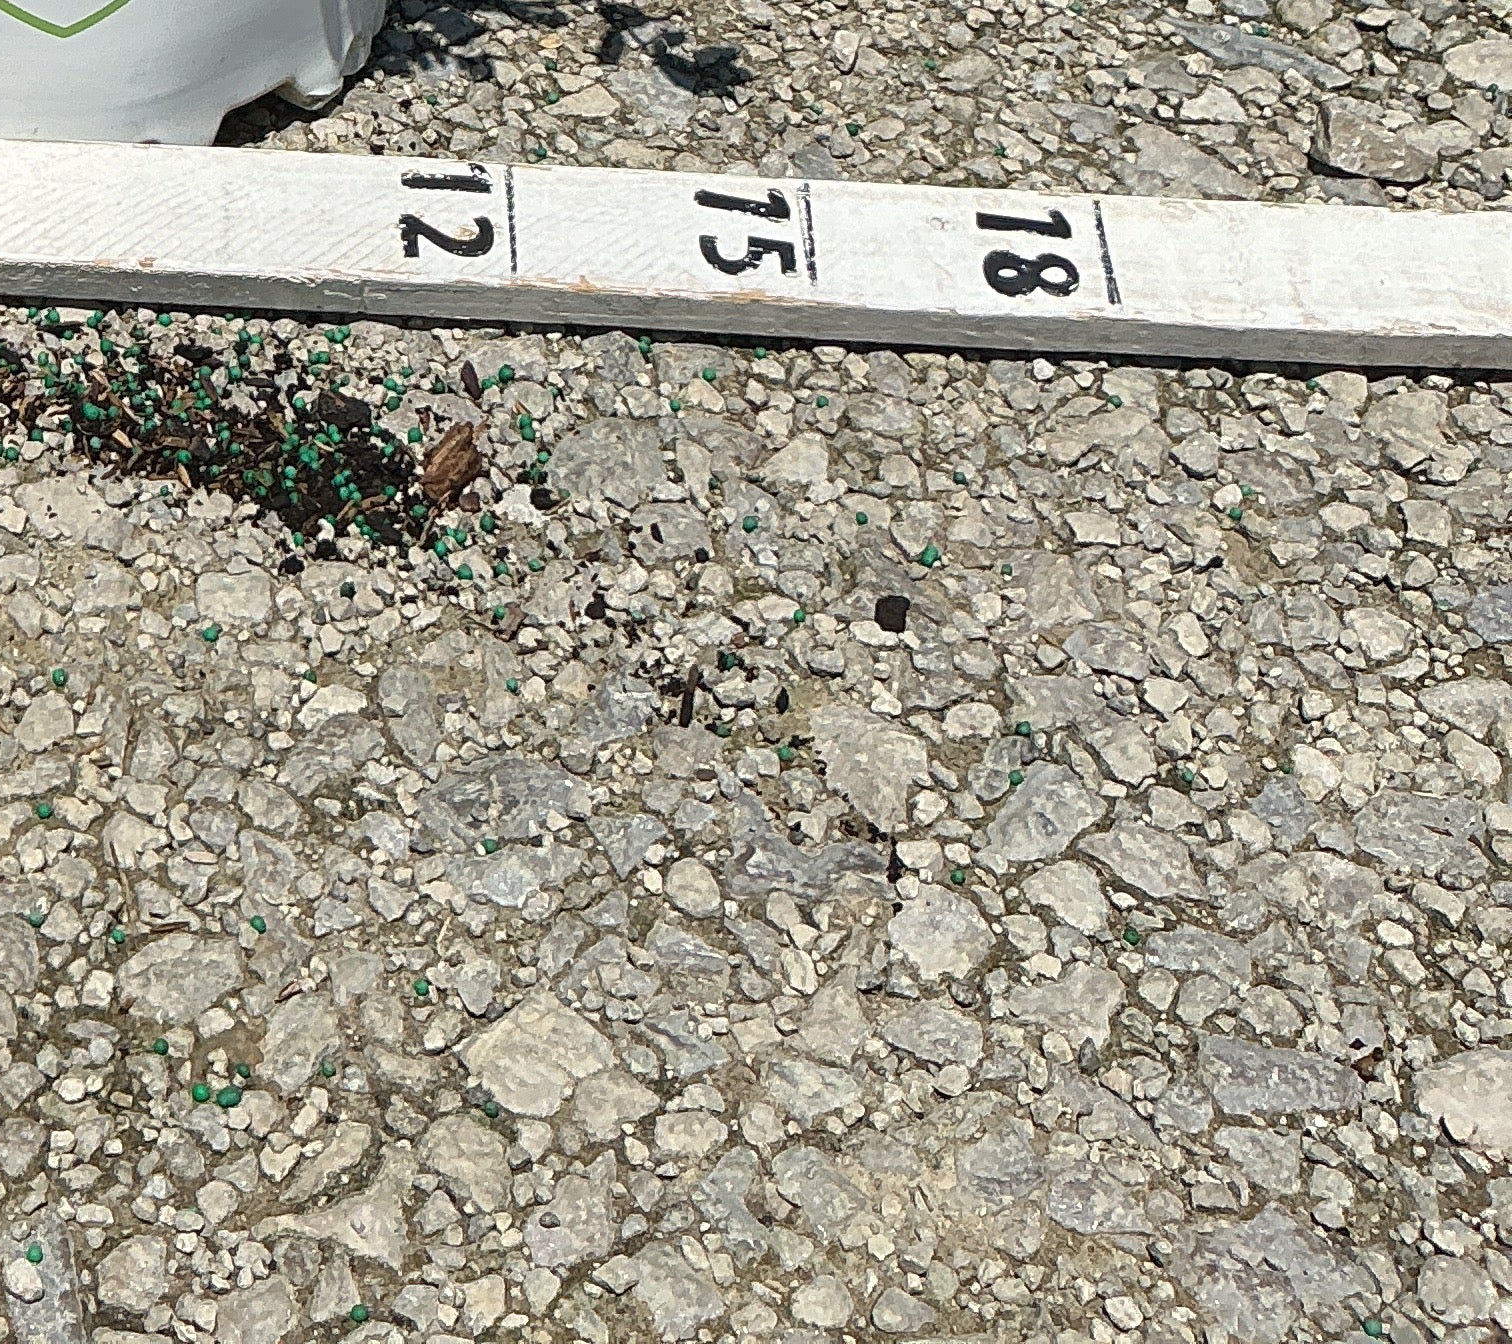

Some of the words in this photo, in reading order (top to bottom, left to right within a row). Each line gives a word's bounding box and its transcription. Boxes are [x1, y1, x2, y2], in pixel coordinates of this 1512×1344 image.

[398, 162, 495, 258] 12
[693, 187, 798, 277] 15
[974, 208, 1081, 298] 18
